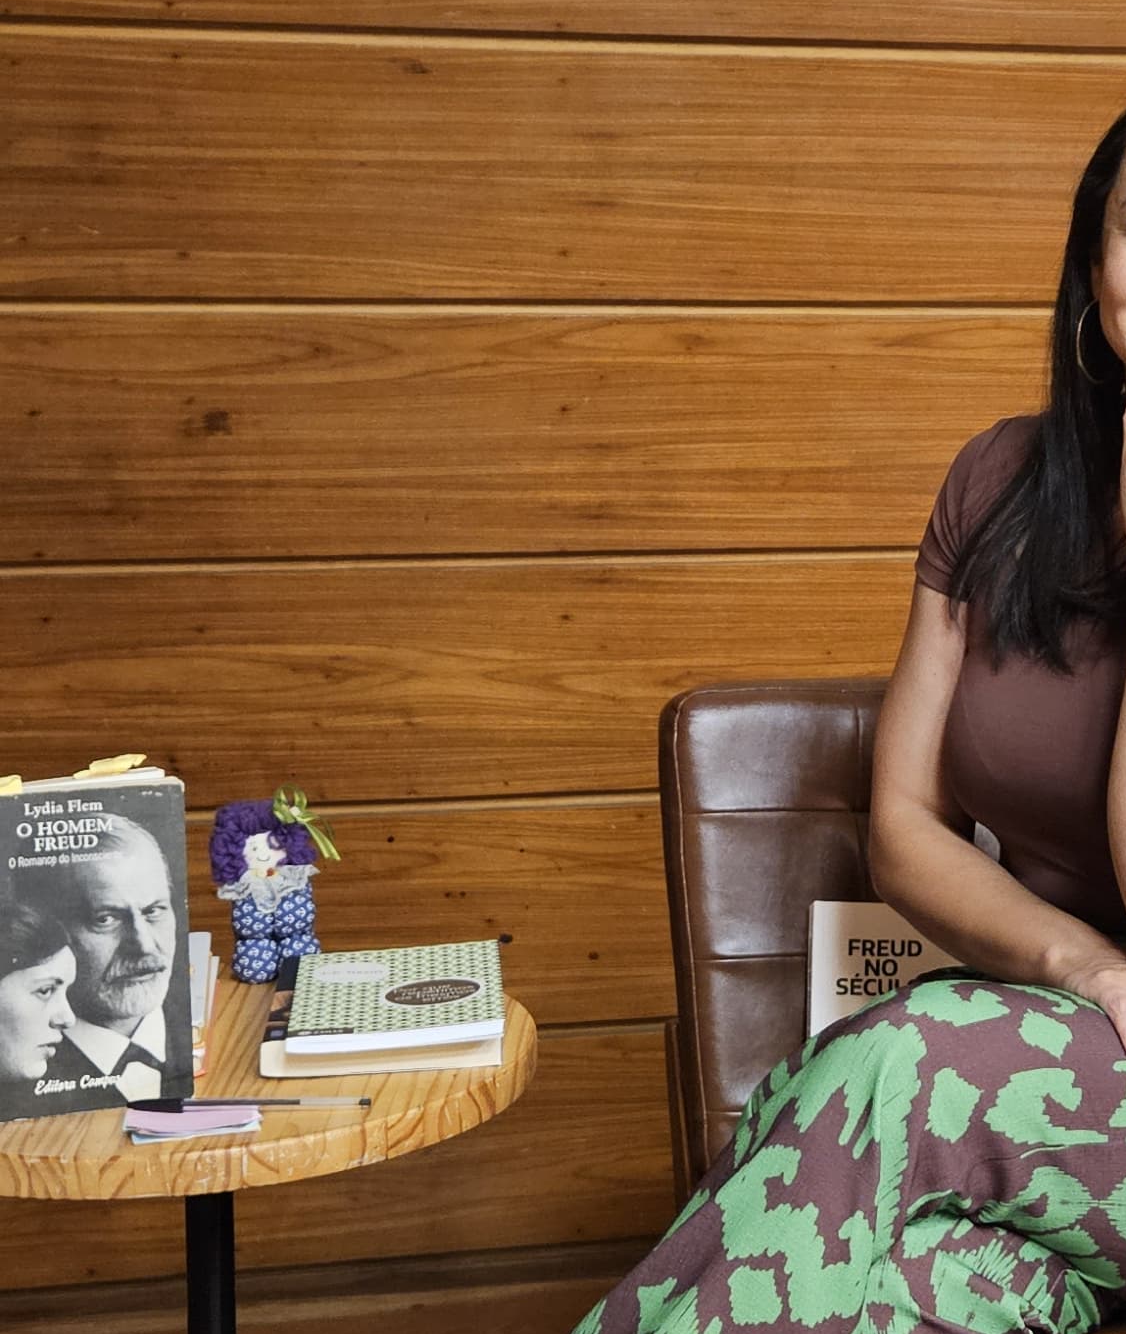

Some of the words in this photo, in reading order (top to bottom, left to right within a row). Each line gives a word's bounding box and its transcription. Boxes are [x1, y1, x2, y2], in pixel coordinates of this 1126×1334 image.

[24, 801, 64, 819] Lydia
[67, 798, 103, 813] Flem
[16, 822, 33, 838] O
[37, 817, 113, 837] HOMEM
[34, 834, 99, 852] FREUD
[847, 938, 923, 957] FREUD
[863, 958, 898, 977] NO
